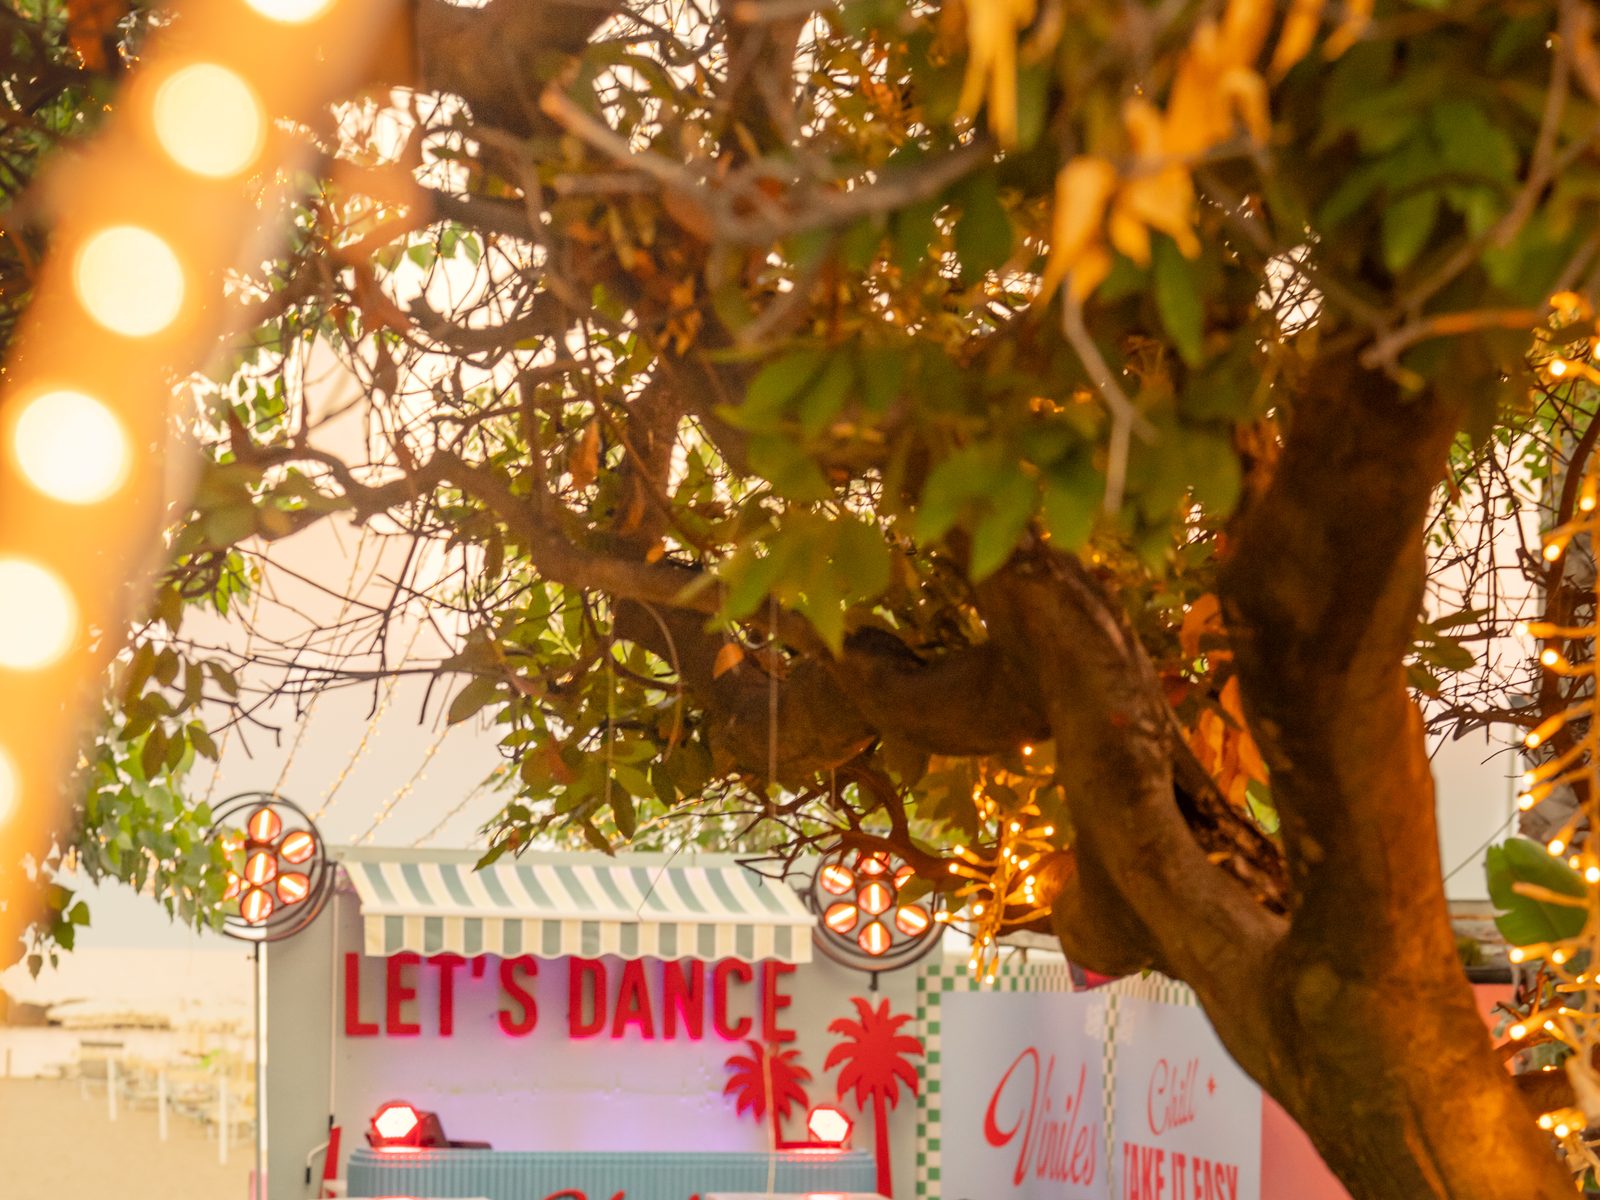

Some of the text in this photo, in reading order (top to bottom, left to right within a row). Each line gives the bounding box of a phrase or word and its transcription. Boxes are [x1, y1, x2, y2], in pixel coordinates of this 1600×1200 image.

[344, 952, 797, 1042] LET'S DANCE
[983, 1046, 1097, 1188] Viniles
[1147, 1057, 1199, 1136] Chill
